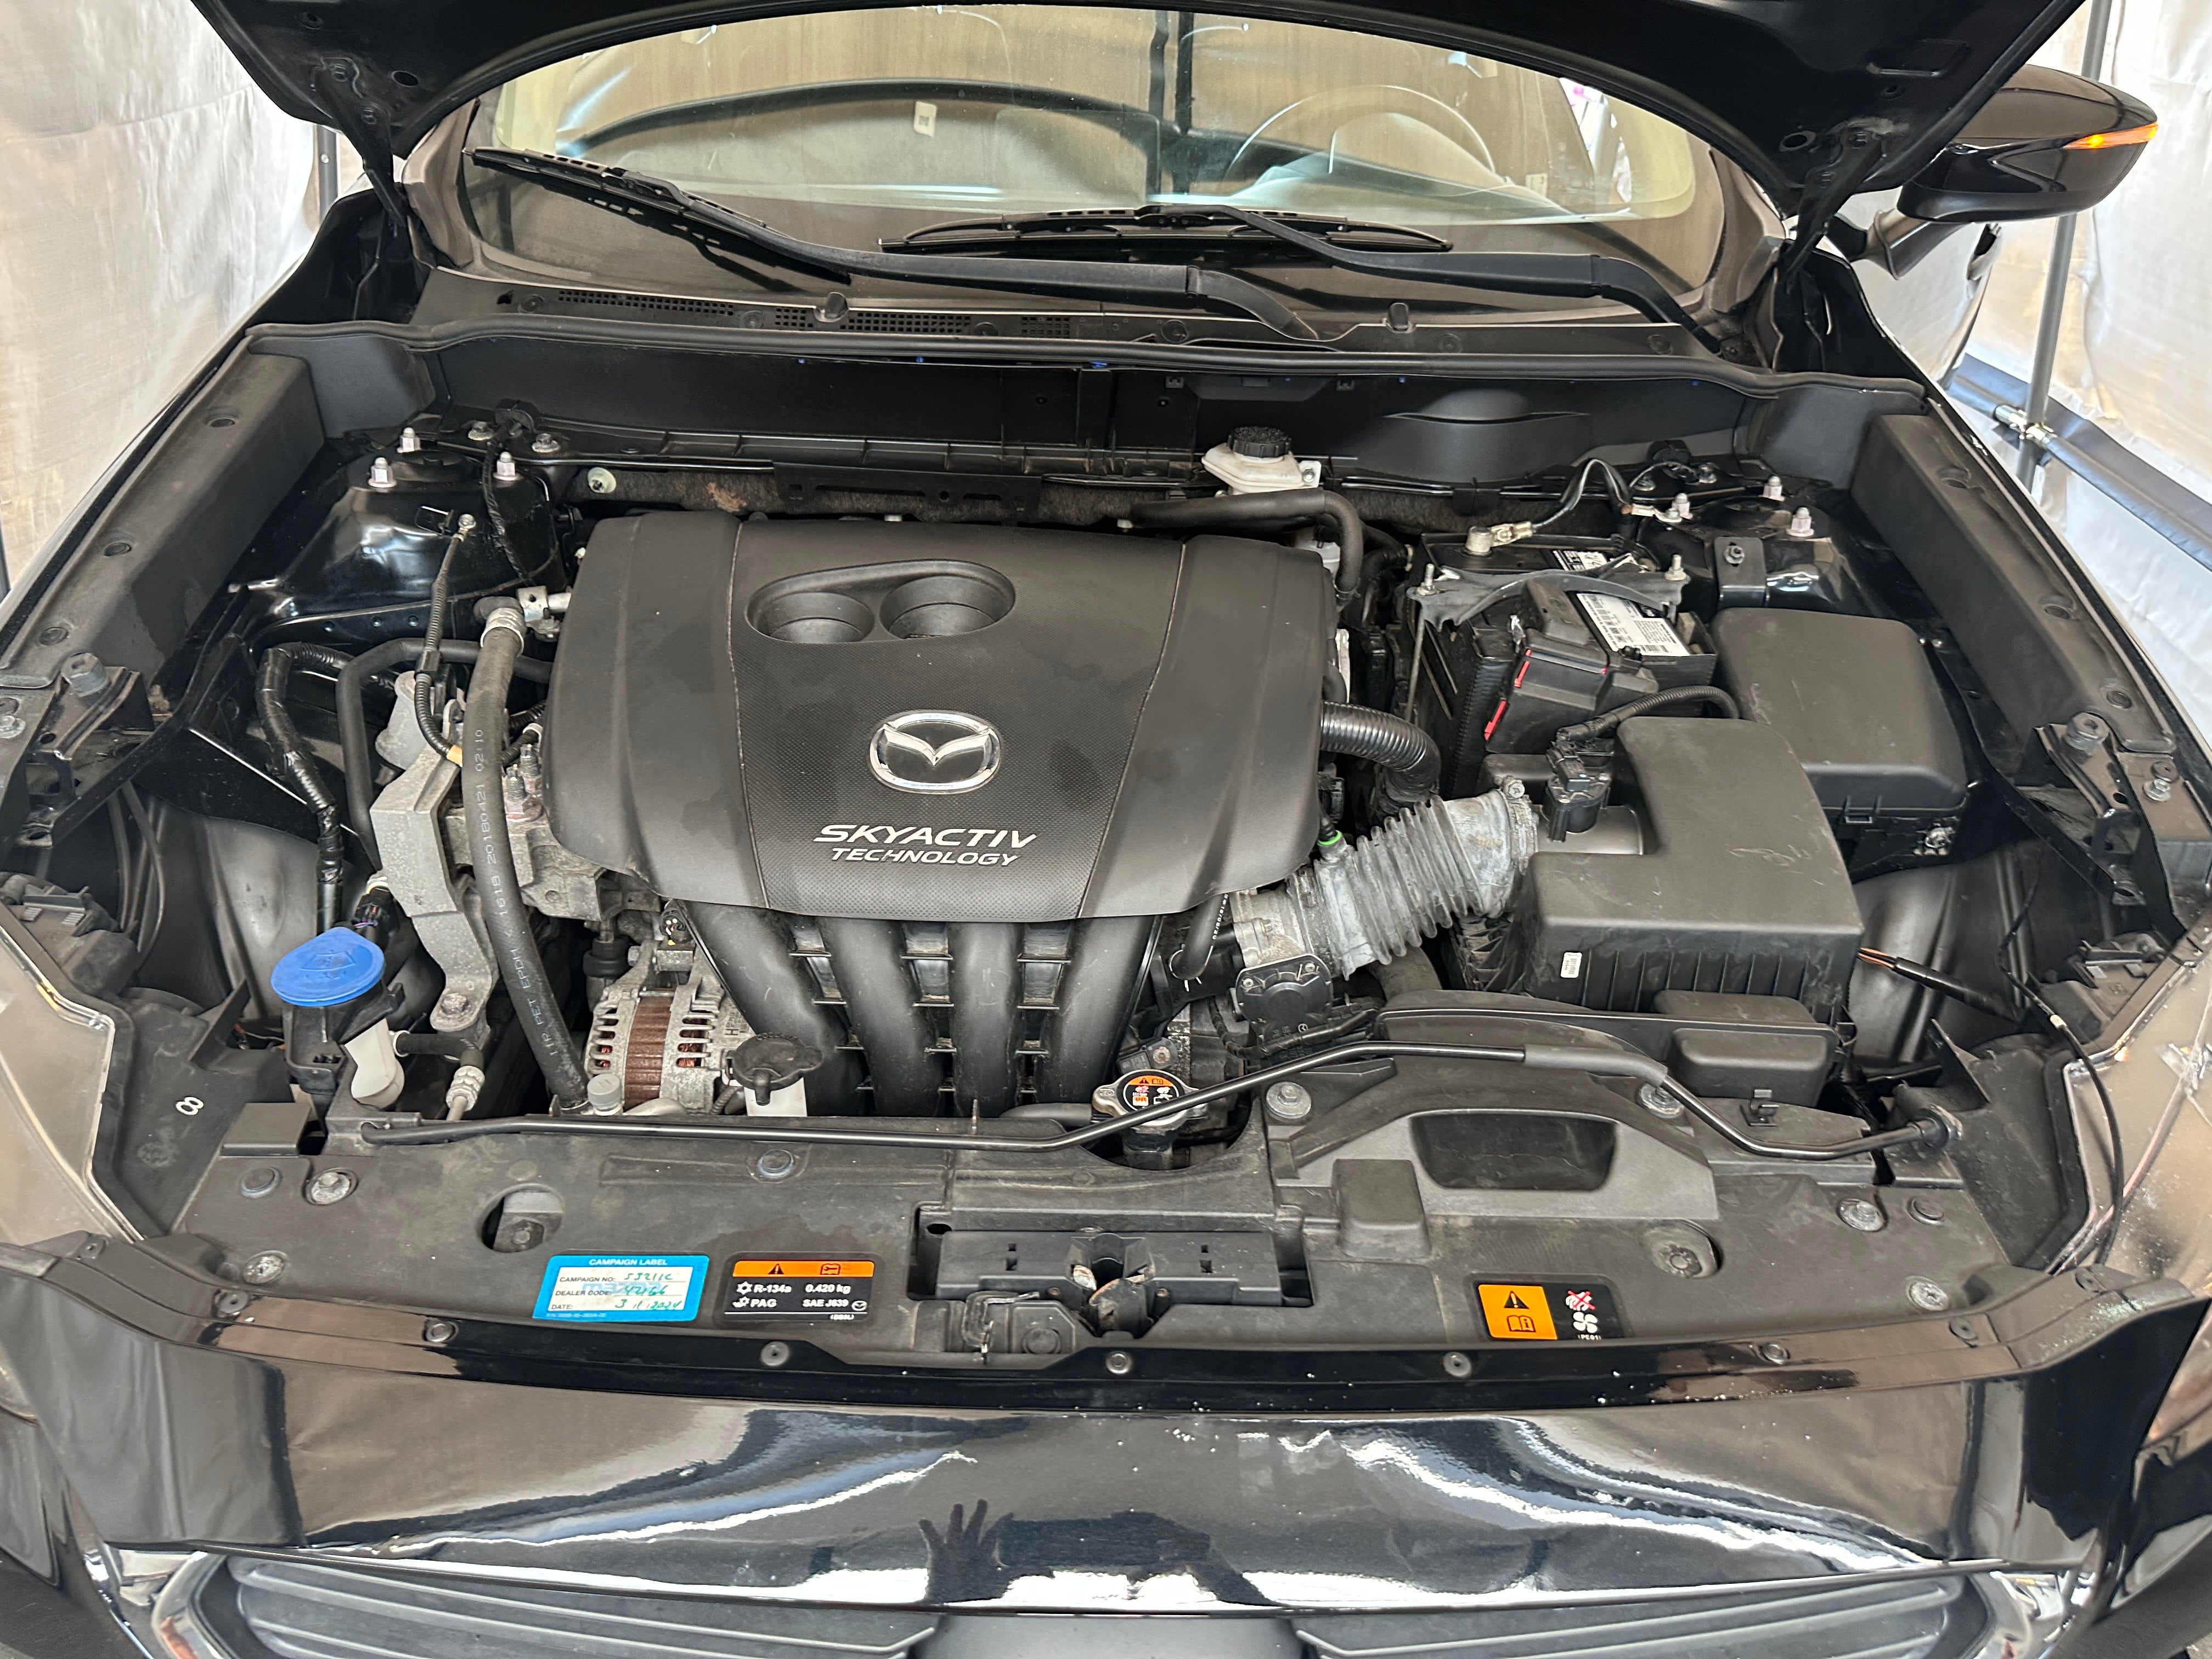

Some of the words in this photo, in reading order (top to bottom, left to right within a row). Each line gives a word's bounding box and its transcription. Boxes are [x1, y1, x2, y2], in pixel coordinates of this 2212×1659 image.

[813, 824, 1037, 848] SKYACTIV
[832, 848, 1018, 866] TECHNOLOGY
[753, 1284, 792, 1293] R-134a
[805, 1284, 834, 1293] 0.420
[836, 1284, 851, 1294] kg
[750, 1299, 777, 1308] PAG
[802, 1299, 824, 1307] SAE
[825, 1299, 849, 1307] J639
